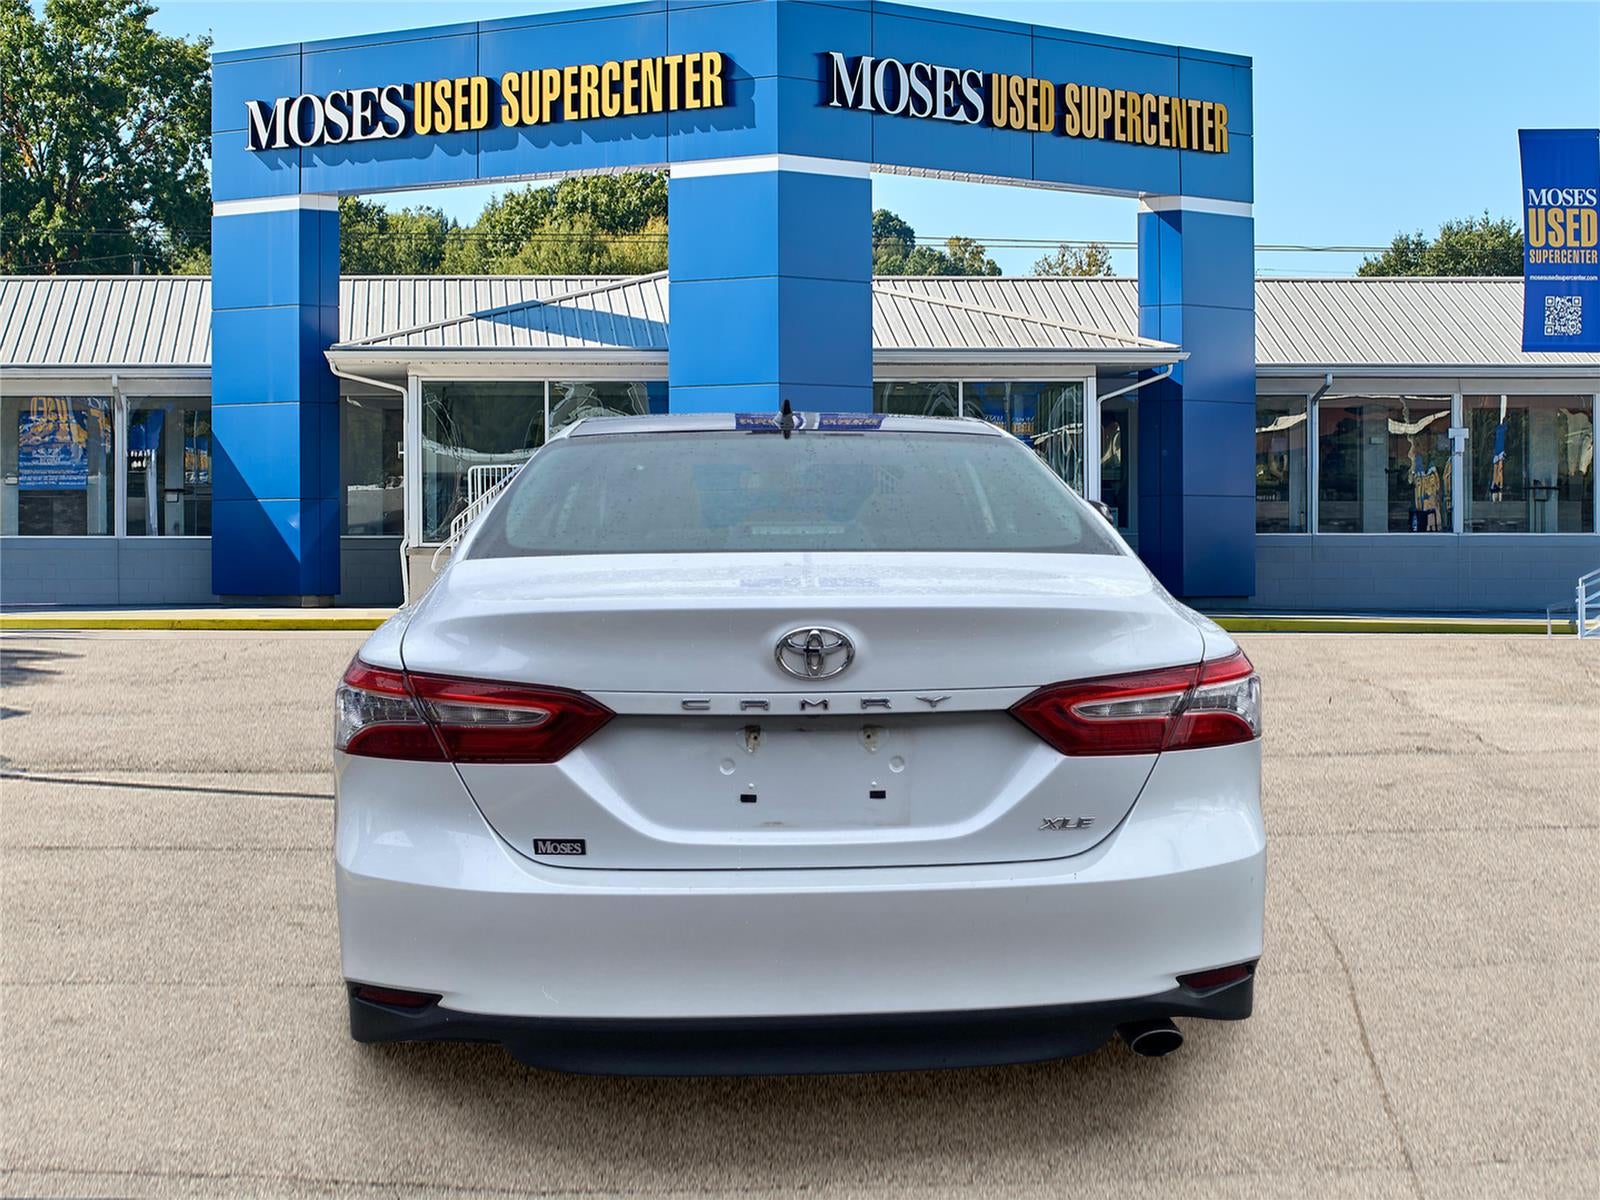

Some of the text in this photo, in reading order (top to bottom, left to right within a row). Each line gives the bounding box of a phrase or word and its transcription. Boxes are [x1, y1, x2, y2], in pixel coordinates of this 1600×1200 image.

[244, 51, 724, 152] MOSES USED SUPERCENTER
[828, 51, 1229, 154] MOSES USED SUPERCENTER
[1527, 188, 1597, 206] MOSES
[1528, 207, 1598, 248] USED
[1529, 249, 1598, 265] SUPERCENTER
[681, 696, 952, 711] CAMRY
[1039, 816, 1096, 831] XLE
[537, 840, 582, 854] MOSES
